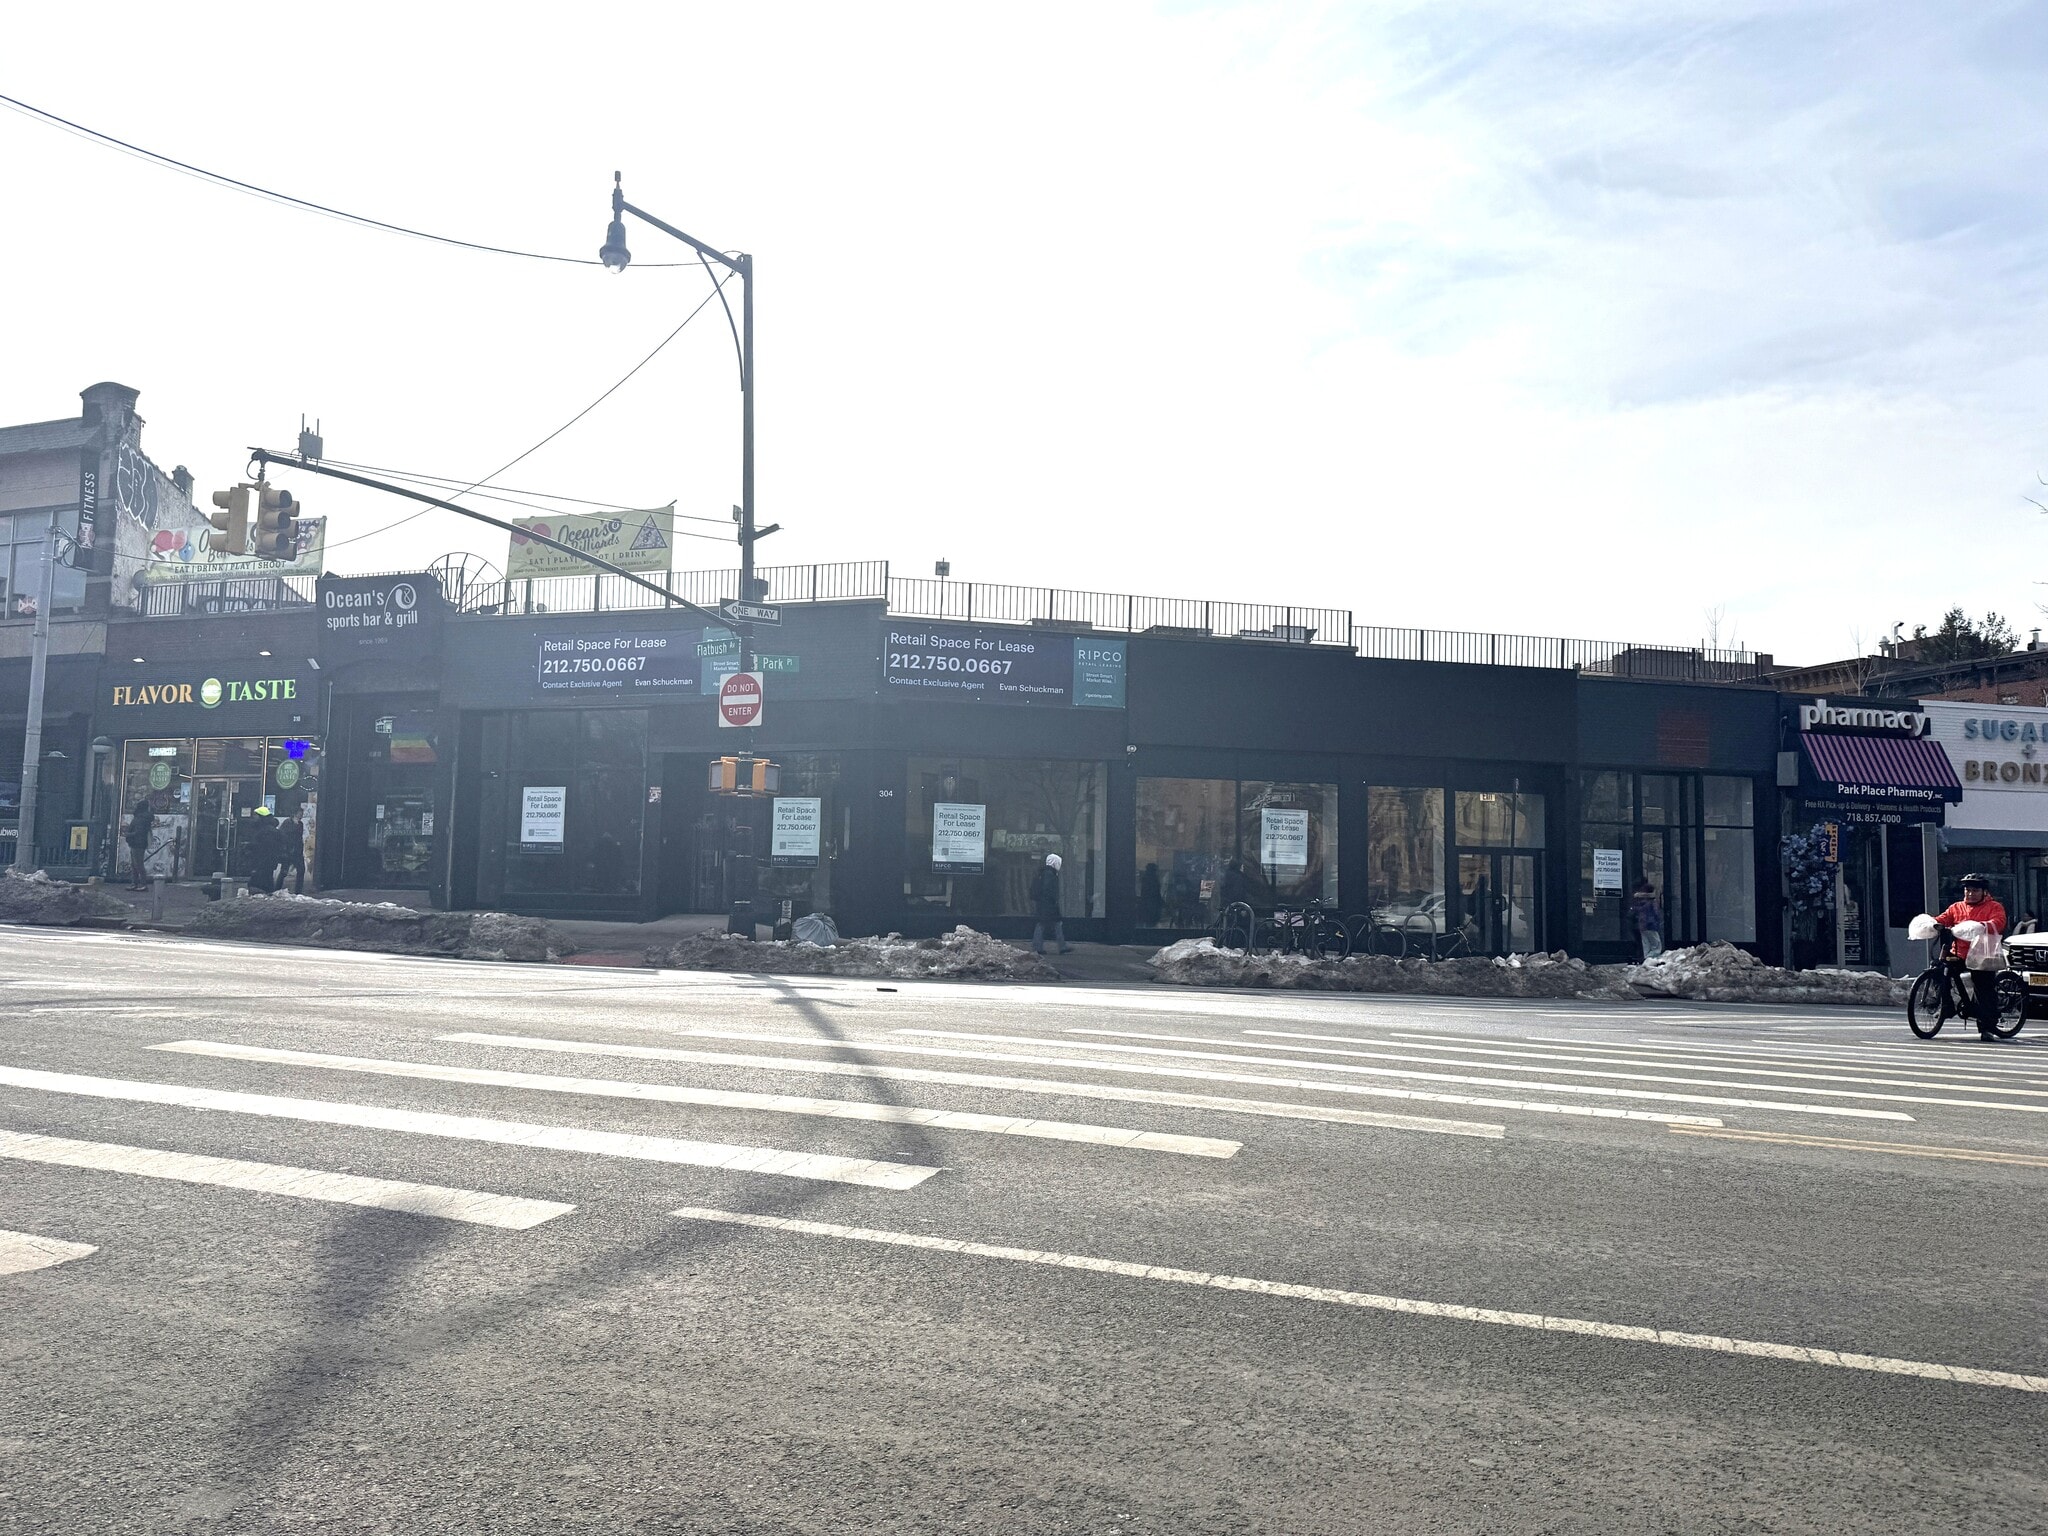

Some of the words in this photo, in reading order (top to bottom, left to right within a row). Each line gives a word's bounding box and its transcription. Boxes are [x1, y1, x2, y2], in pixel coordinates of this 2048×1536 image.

[83, 472, 95, 521] FITNESS
[553, 556, 574, 564] PLAY
[174, 565, 189, 573] EAT
[197, 564, 223, 572] DRINK
[230, 562, 250, 570] PLAY
[258, 561, 286, 569] SHOOT
[325, 590, 385, 608] Ocean's
[732, 606, 749, 616] ONE
[757, 609, 775, 619] WAY
[326, 614, 360, 631] sports
[363, 612, 381, 626] bar
[384, 611, 393, 625] &
[396, 610, 418, 627] grill
[544, 639, 575, 652] Retail
[576, 638, 611, 652] Space
[614, 638, 632, 649] For
[634, 637, 667, 648] Lease
[890, 632, 927, 647] Retail
[930, 635, 970, 650] Space
[974, 638, 995, 651] For
[998, 640, 1035, 653] Lease
[697, 642, 728, 657] Flatbush
[1078, 649, 1122, 662] RIPCO
[543, 656, 646, 674] 212.750.0667
[763, 657, 784, 670] Park
[787, 658, 793, 666] Pl
[889, 653, 1012, 675] 212.750.0667
[542, 680, 569, 689] Contact
[570, 680, 601, 688] Exclusive
[602, 679, 623, 689] Agent
[635, 678, 651, 686] Evan
[652, 677, 693, 686] Schuckman
[727, 684, 737, 693] DO
[740, 683, 755, 692] NOT
[889, 676, 922, 686] Contact
[923, 678, 960, 688] Exclusive
[961, 681, 985, 690] Agent
[999, 683, 1018, 692] Evan
[1019, 684, 1064, 694] Schuckman
[112, 684, 194, 705] FLAVOR
[226, 679, 297, 701] TASTE
[728, 707, 752, 716] ENTER
[1801, 698, 1927, 737] pharmacy
[1838, 784, 1859, 795] Park
[1861, 785, 1886, 796] Place
[543, 795, 562, 803] Space
[796, 806, 816, 815] Space
[1805, 800, 1817, 808] Free
[1825, 801, 1846, 810] Pick-up
[1851, 802, 1871, 811] Delivery
[1920, 805, 1942, 813] Products
[938, 812, 958, 820] Retail
[959, 813, 981, 821] Space
[1846, 813, 1901, 823] 718.857.4000
[956, 820, 976, 828] Lease
